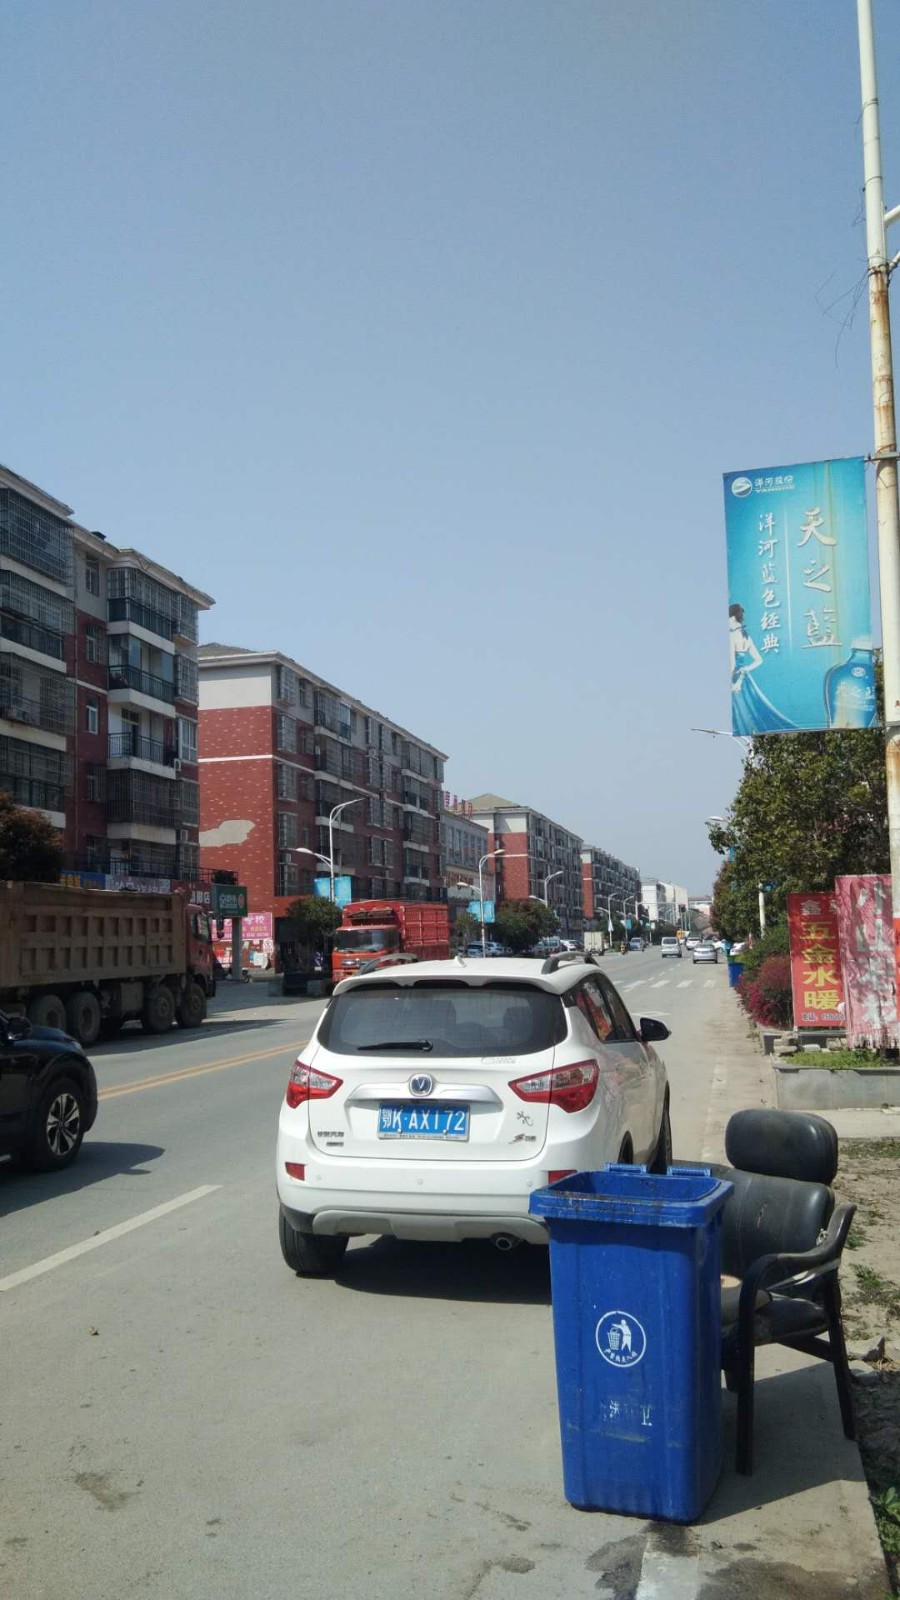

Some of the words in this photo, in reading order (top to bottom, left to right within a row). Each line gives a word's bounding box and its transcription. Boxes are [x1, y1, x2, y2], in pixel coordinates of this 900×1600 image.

[758, 513, 781, 654] 洋河蓝色经典
[800, 921, 839, 1010] 五金水暖
